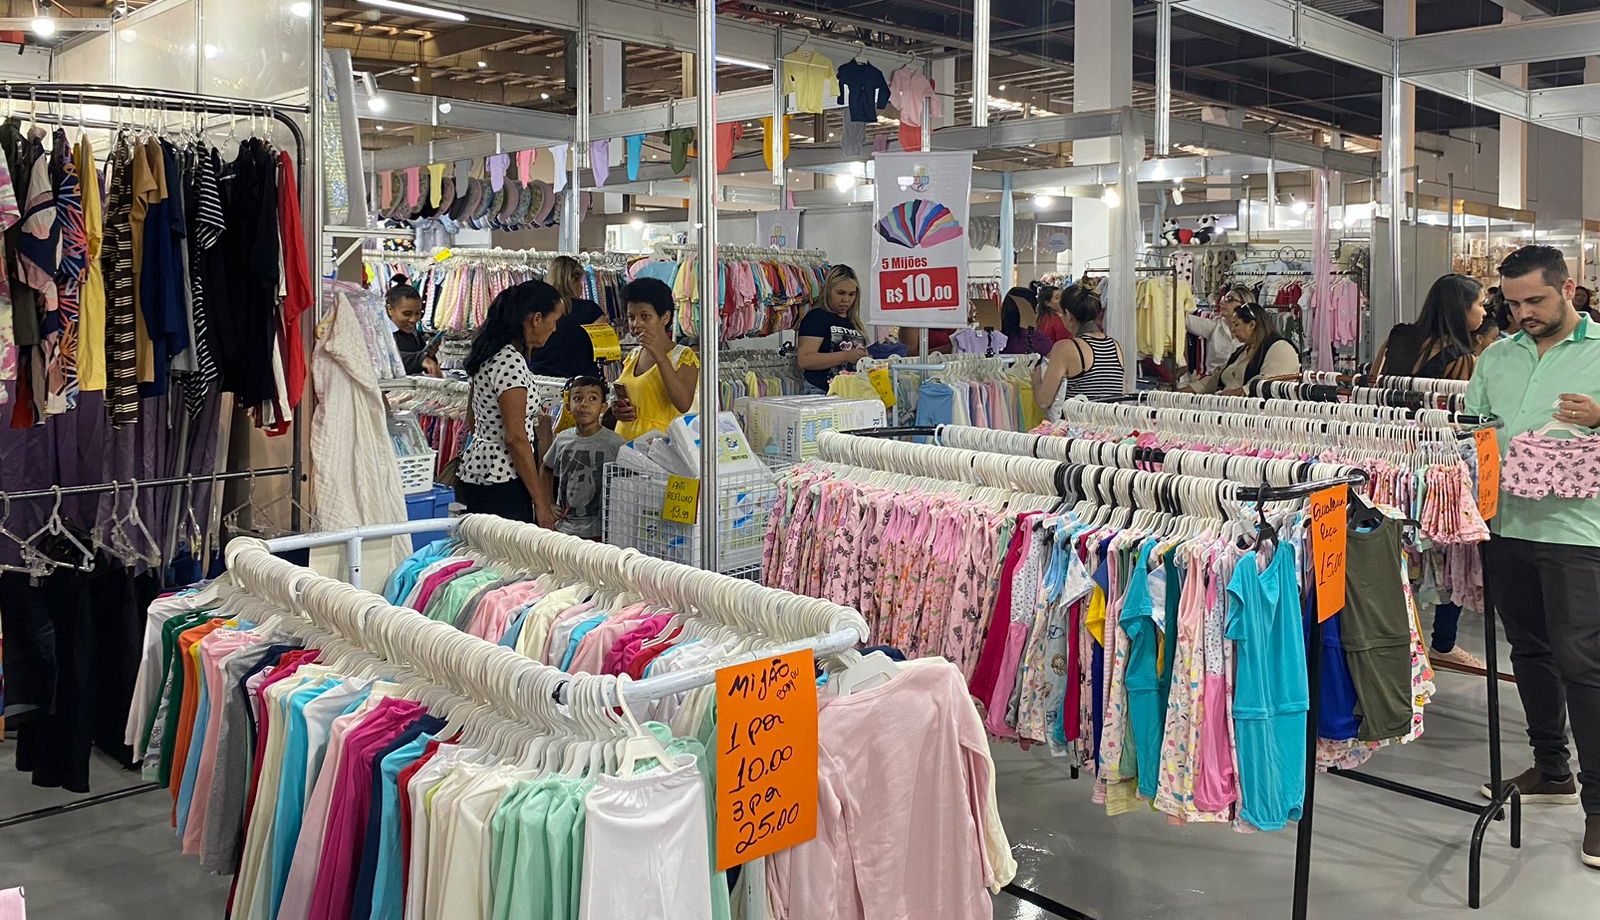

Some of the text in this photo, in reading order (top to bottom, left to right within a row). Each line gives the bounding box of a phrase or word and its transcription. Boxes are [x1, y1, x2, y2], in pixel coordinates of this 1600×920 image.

[881, 255, 928, 270] 5 Mijões
[725, 722, 740, 755] 1
[732, 800, 744, 823] 3
